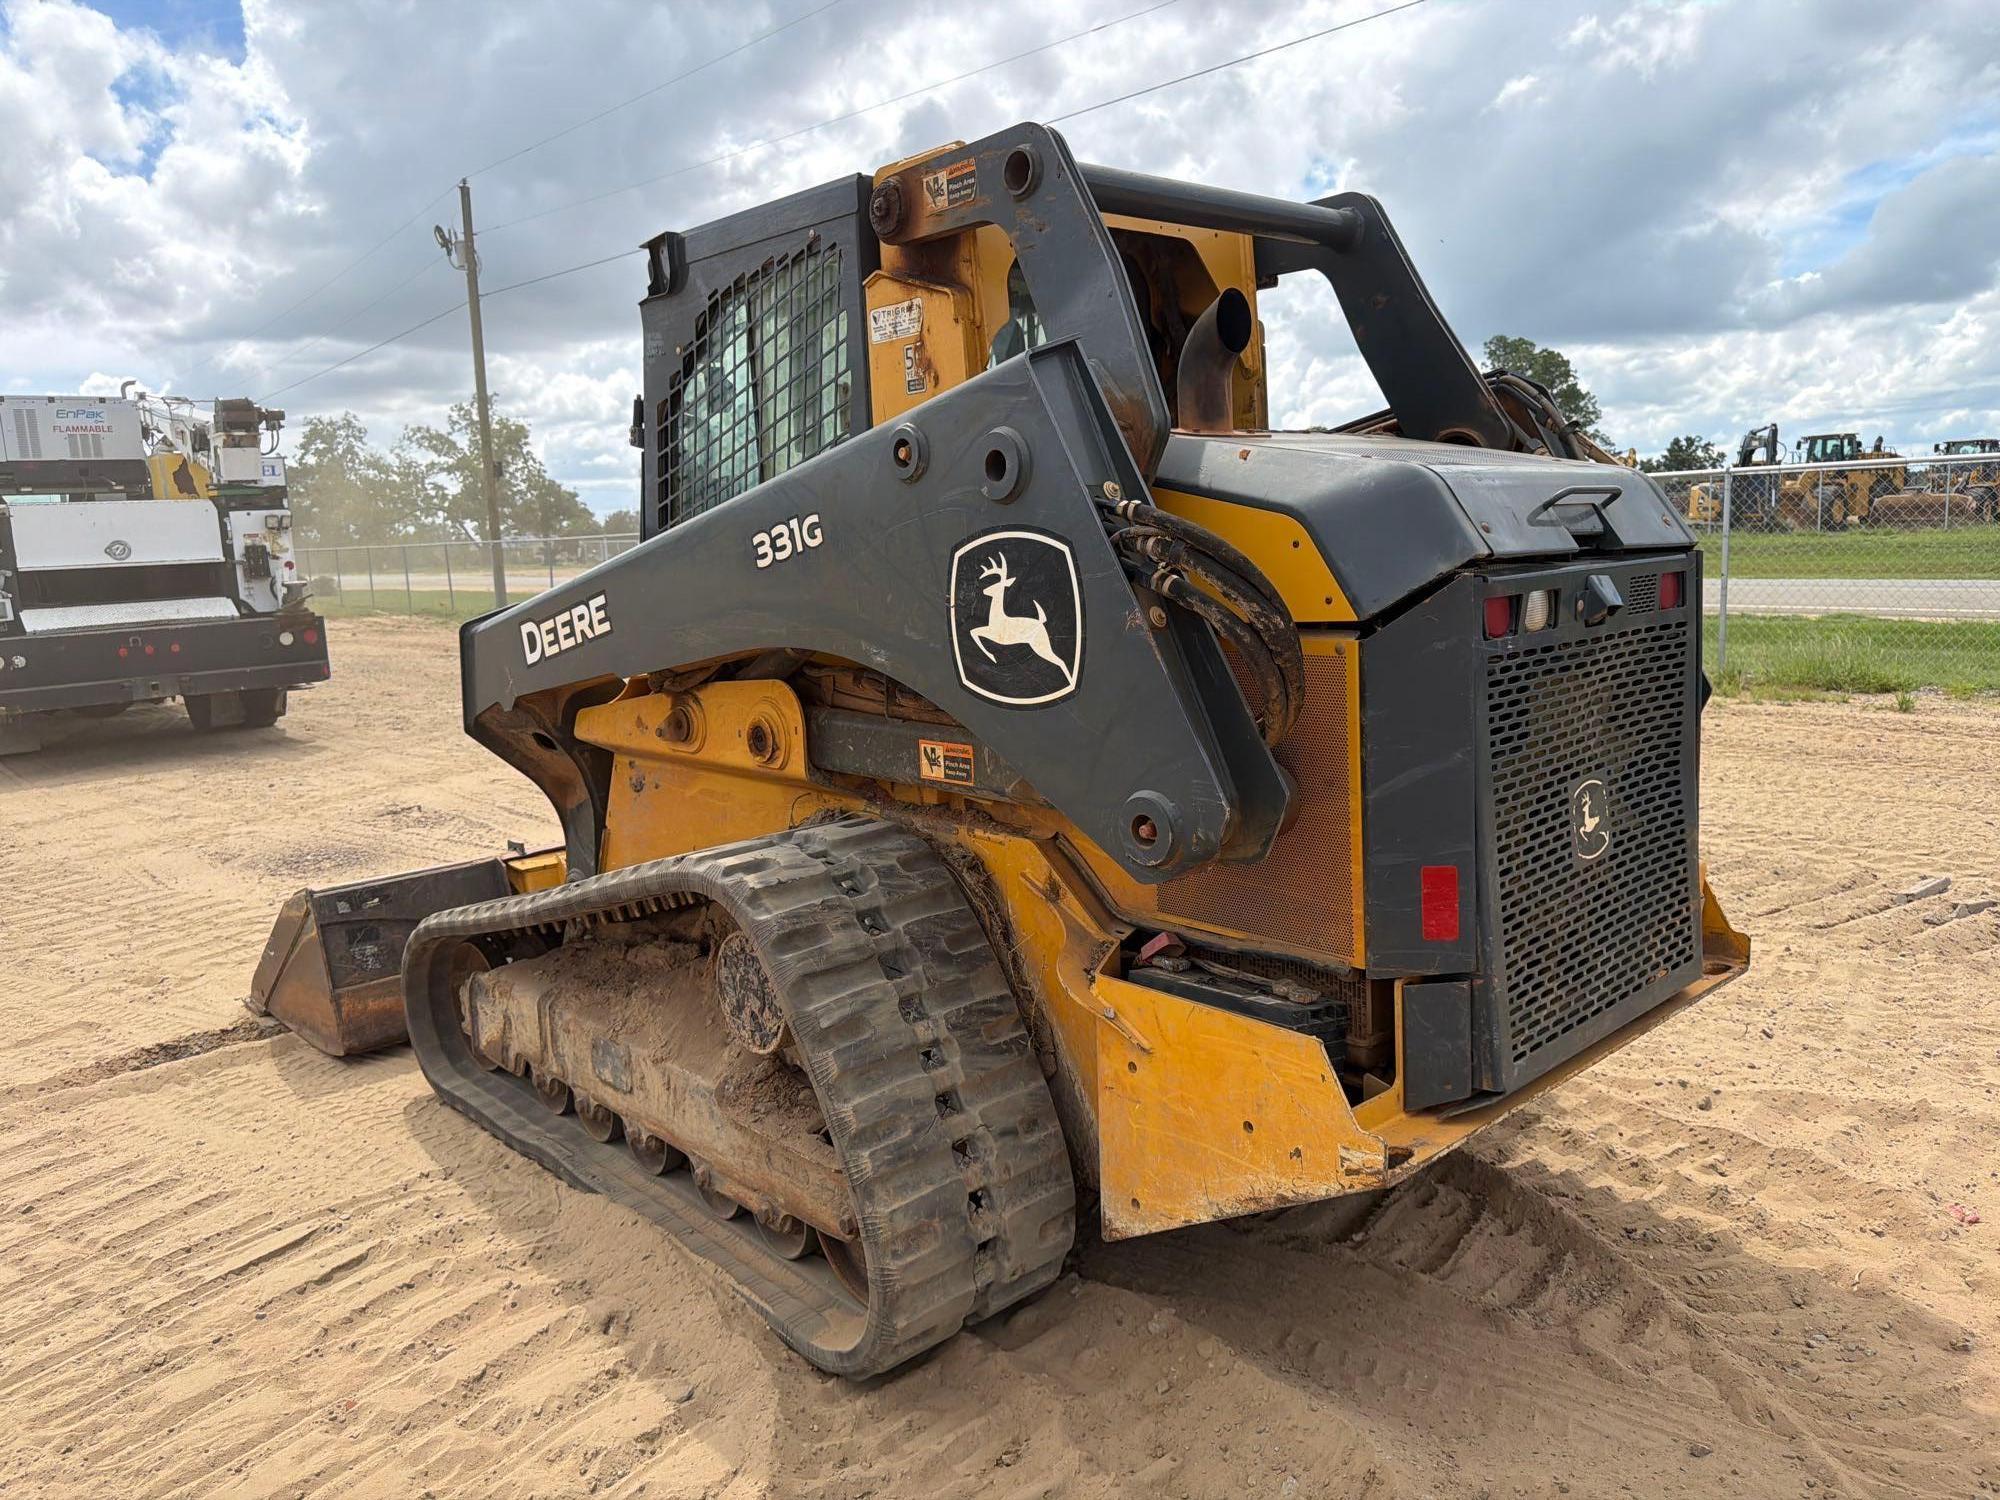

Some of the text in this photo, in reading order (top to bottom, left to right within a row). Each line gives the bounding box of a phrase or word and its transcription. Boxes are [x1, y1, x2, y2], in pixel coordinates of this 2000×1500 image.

[881, 303, 921, 319] TRIGREN
[56, 409, 104, 419] EnPak
[53, 424, 113, 433] FLAMMABLE
[752, 514, 823, 568] 331G
[520, 594, 612, 666] DEERE
